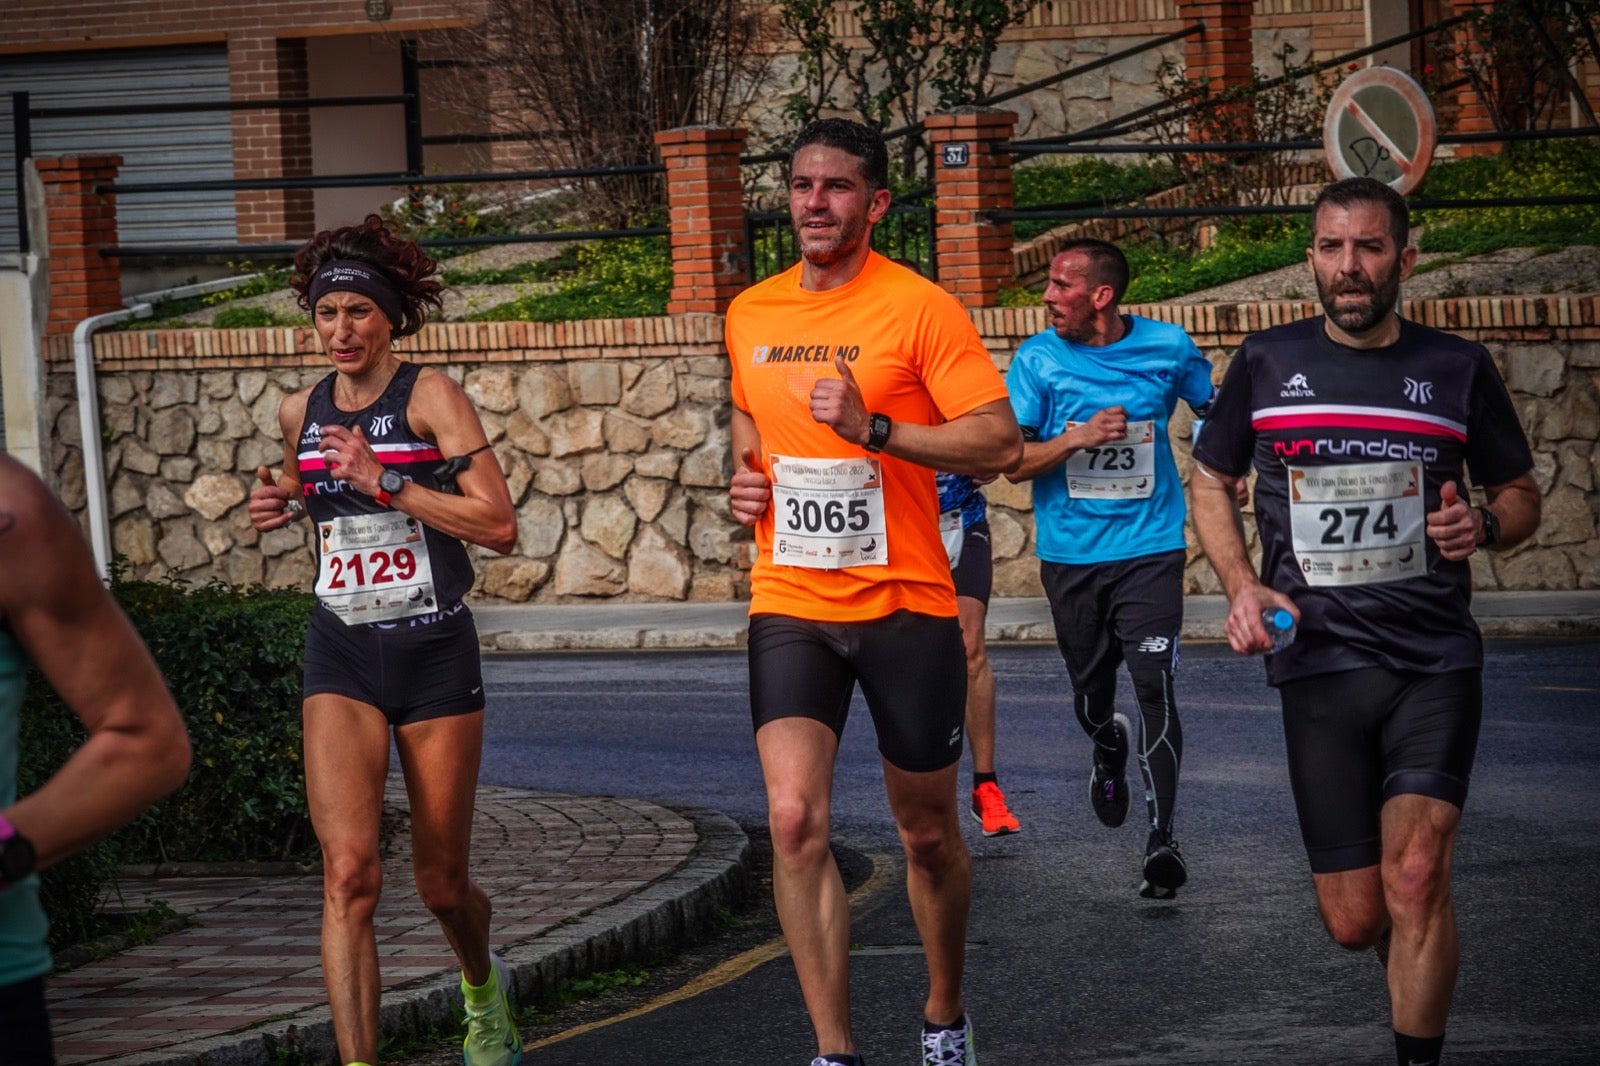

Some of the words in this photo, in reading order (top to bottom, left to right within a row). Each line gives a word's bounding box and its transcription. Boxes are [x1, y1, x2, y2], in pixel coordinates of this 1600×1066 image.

[1085, 447, 1136, 471] 723
[1273, 438, 1438, 462] runrundata
[786, 497, 870, 533] 3065
[1319, 503, 1398, 545] 274
[328, 548, 417, 590] 2129
